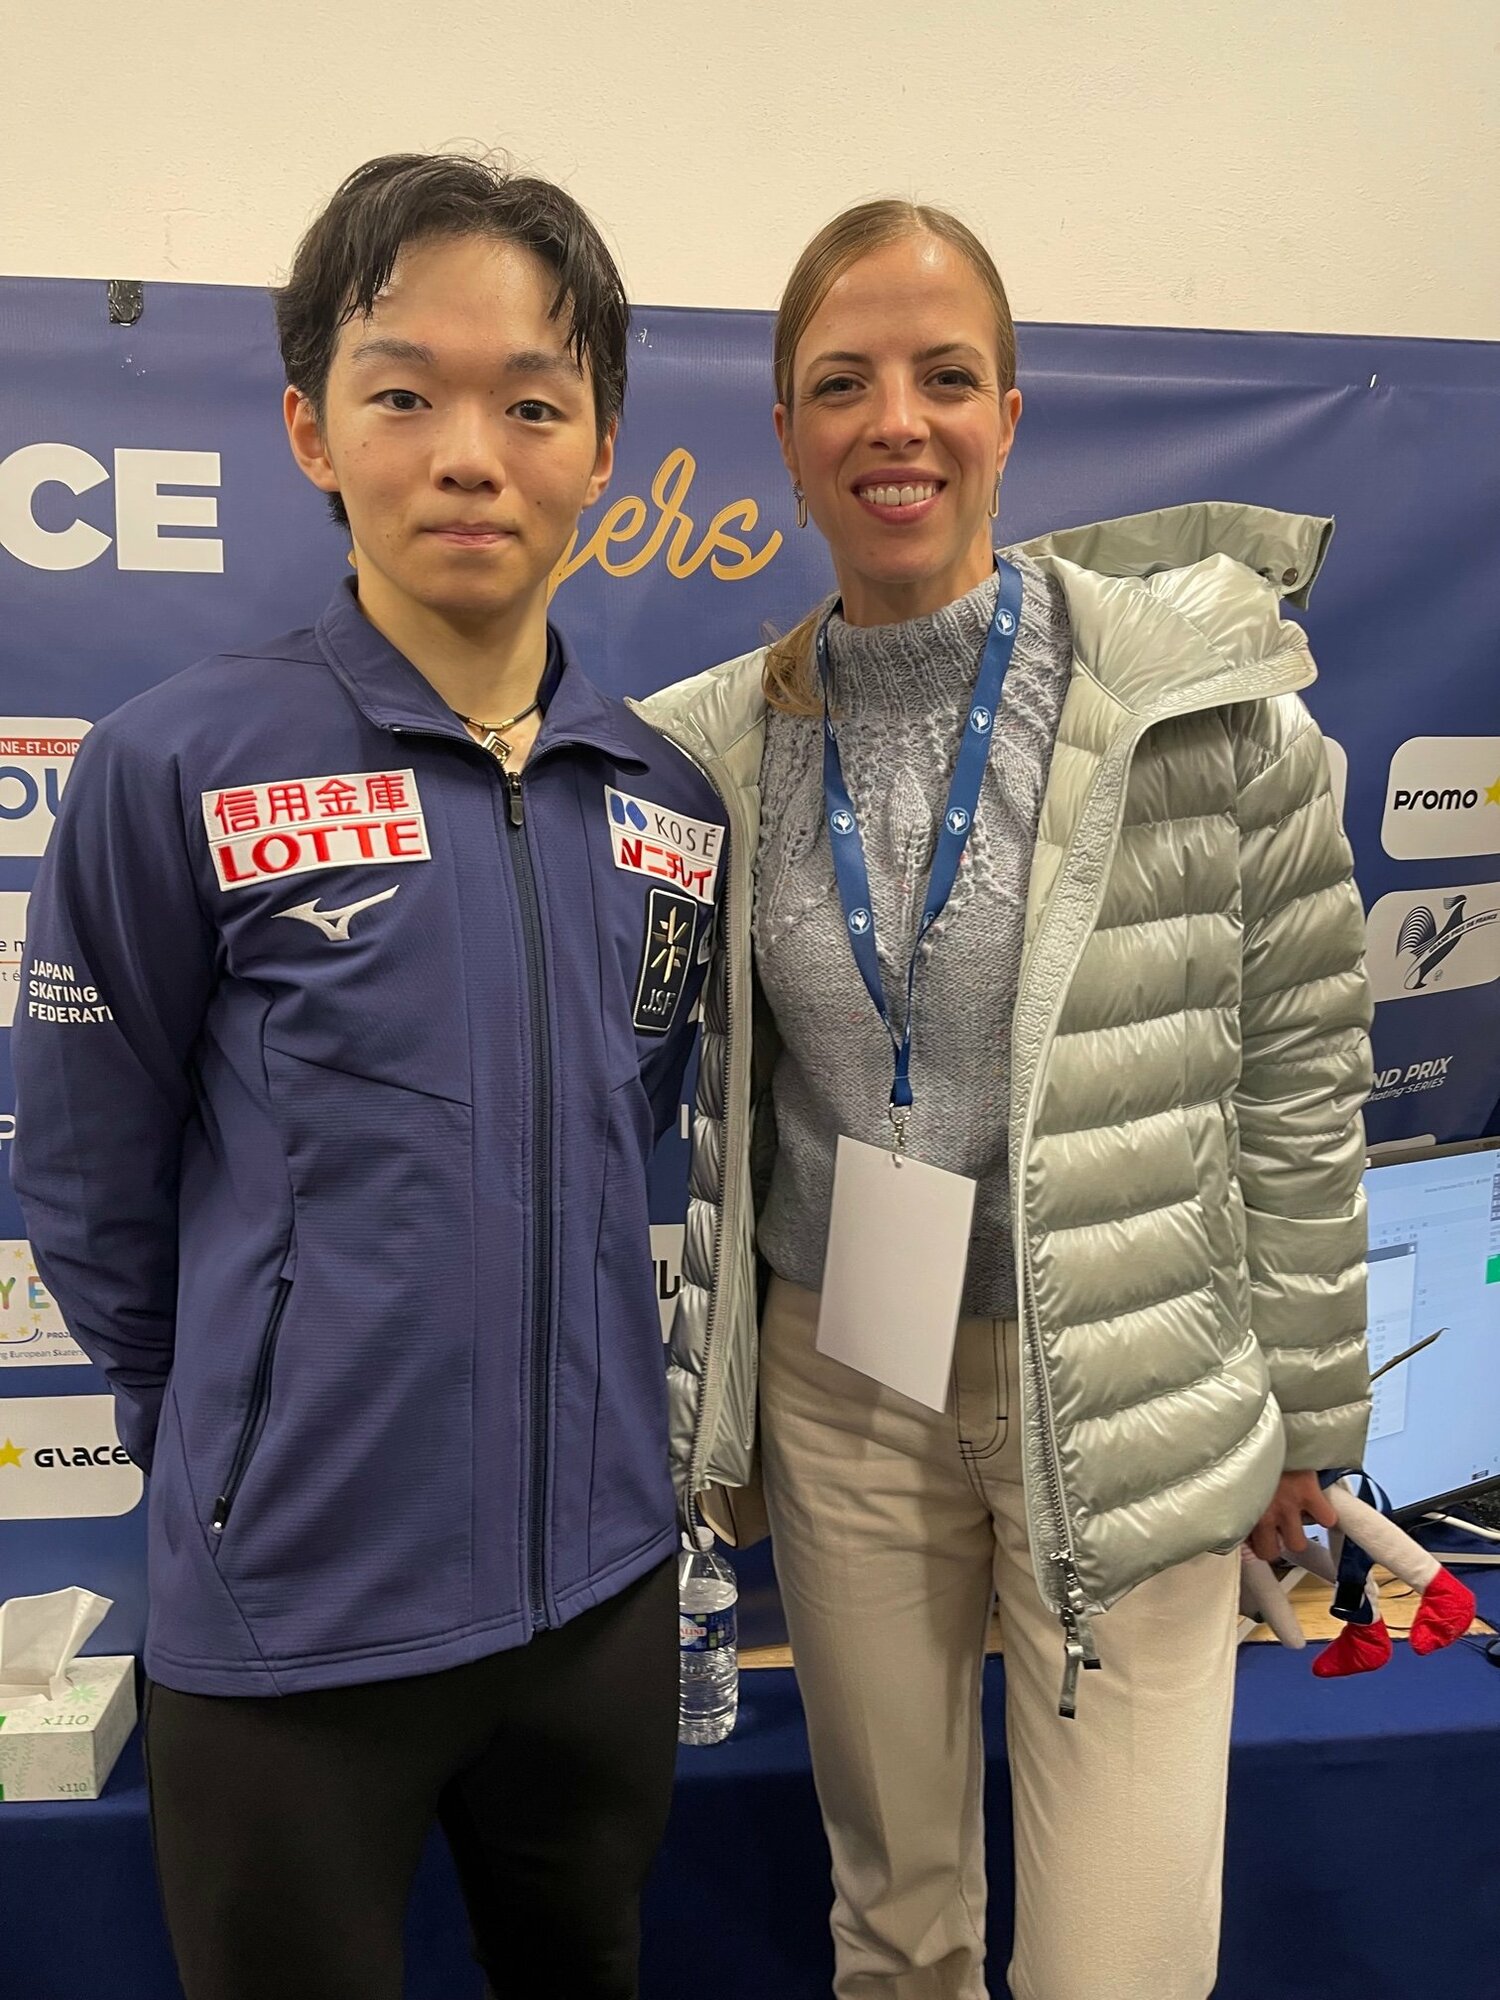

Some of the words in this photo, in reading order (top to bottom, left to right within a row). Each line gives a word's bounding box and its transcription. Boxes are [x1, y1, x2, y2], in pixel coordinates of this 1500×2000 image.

[0, 443, 224, 573] CE
[214, 775, 409, 835] 信用金庫
[654, 813, 717, 859] KOSÉ
[217, 820, 422, 883] LOTTE
[29, 959, 75, 982] JAPAN
[28, 980, 98, 1003] SKATING
[642, 988, 676, 1017] JSF
[1403, 1055, 1453, 1083] PRIX
[1405, 1077, 1447, 1094] SERIES
[9, 1350, 51, 1358] European
[40, 1714, 90, 1726] x110
[57, 1782, 88, 1793] x110
